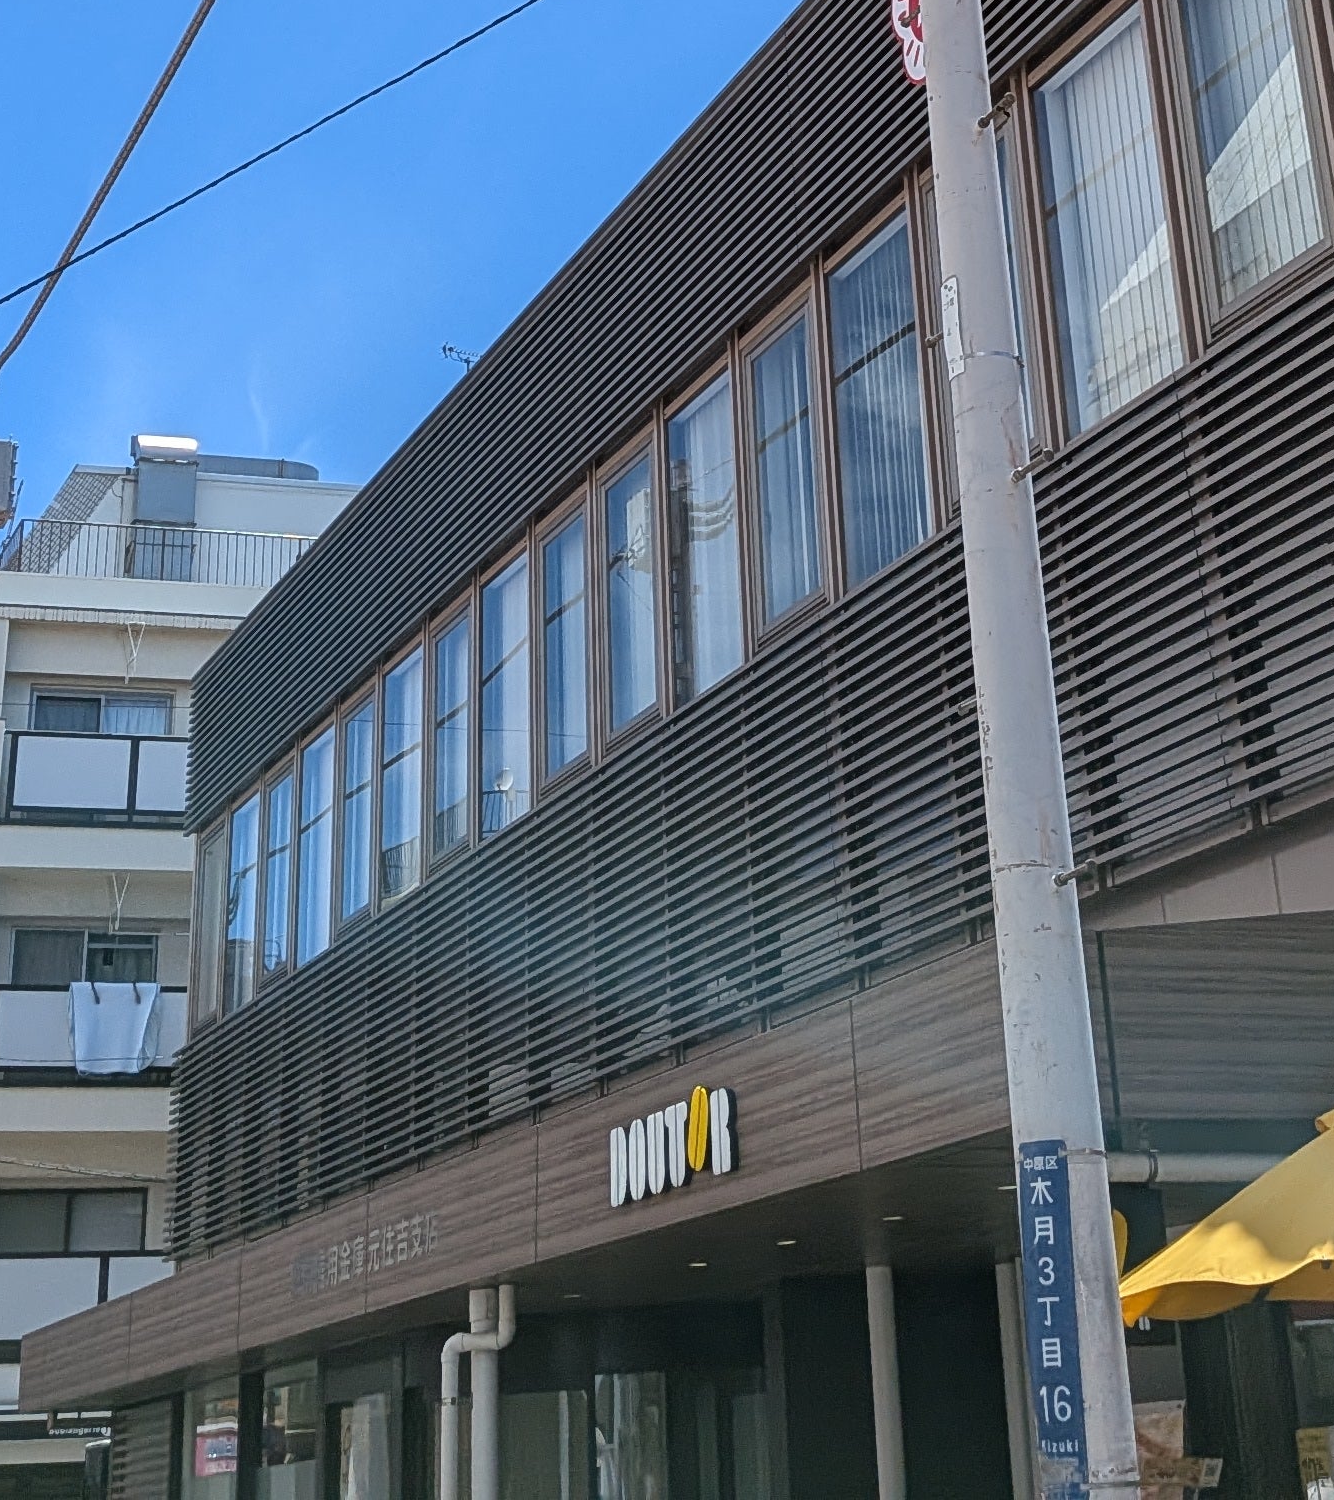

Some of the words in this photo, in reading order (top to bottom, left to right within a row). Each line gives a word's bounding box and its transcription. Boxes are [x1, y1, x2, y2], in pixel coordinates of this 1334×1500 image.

[610, 1085, 734, 1207] DOUTOR
[1023, 1155, 1059, 1171] 中原区
[1041, 1439, 1079, 1452] Kizuki
